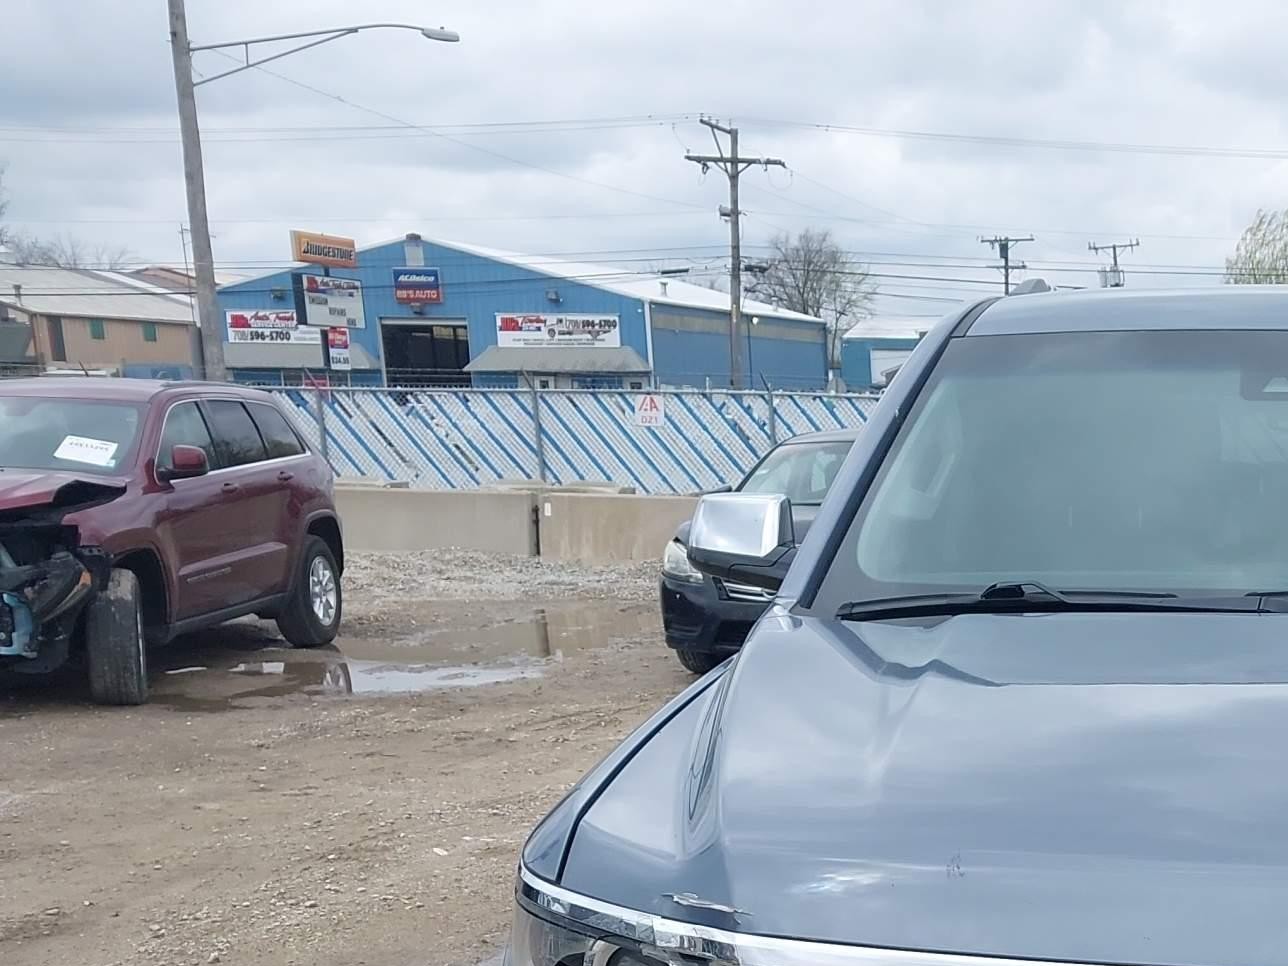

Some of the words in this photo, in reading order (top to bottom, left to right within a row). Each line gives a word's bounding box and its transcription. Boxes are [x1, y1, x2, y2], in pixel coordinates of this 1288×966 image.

[303, 240, 354, 261] BRIDGESTONE
[415, 290, 438, 299] AUTO
[250, 331, 291, 341] 596-5700
